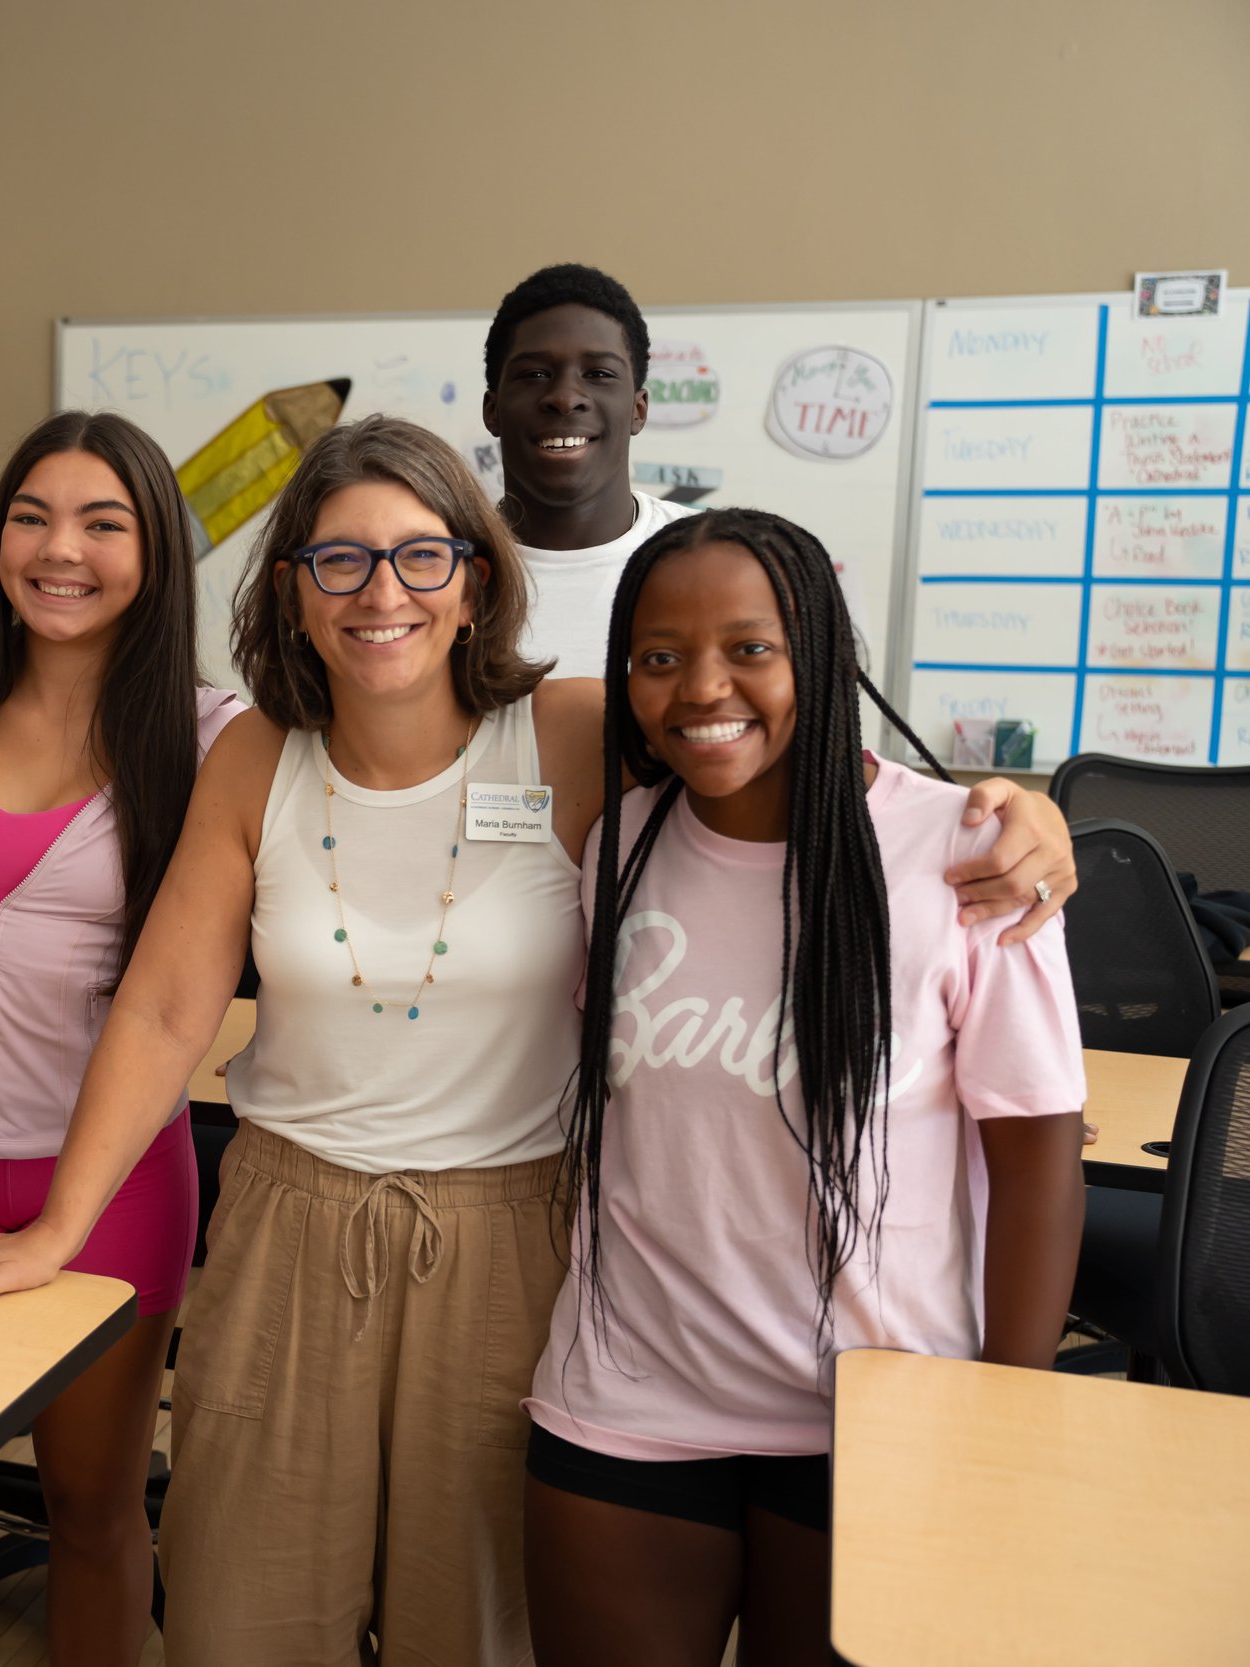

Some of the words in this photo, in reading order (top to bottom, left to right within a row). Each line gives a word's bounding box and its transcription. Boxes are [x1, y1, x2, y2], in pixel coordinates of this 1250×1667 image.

[470, 791, 520, 803] CATHEDRAL
[475, 819, 500, 829] Maria
[502, 820, 542, 831] Burnham
